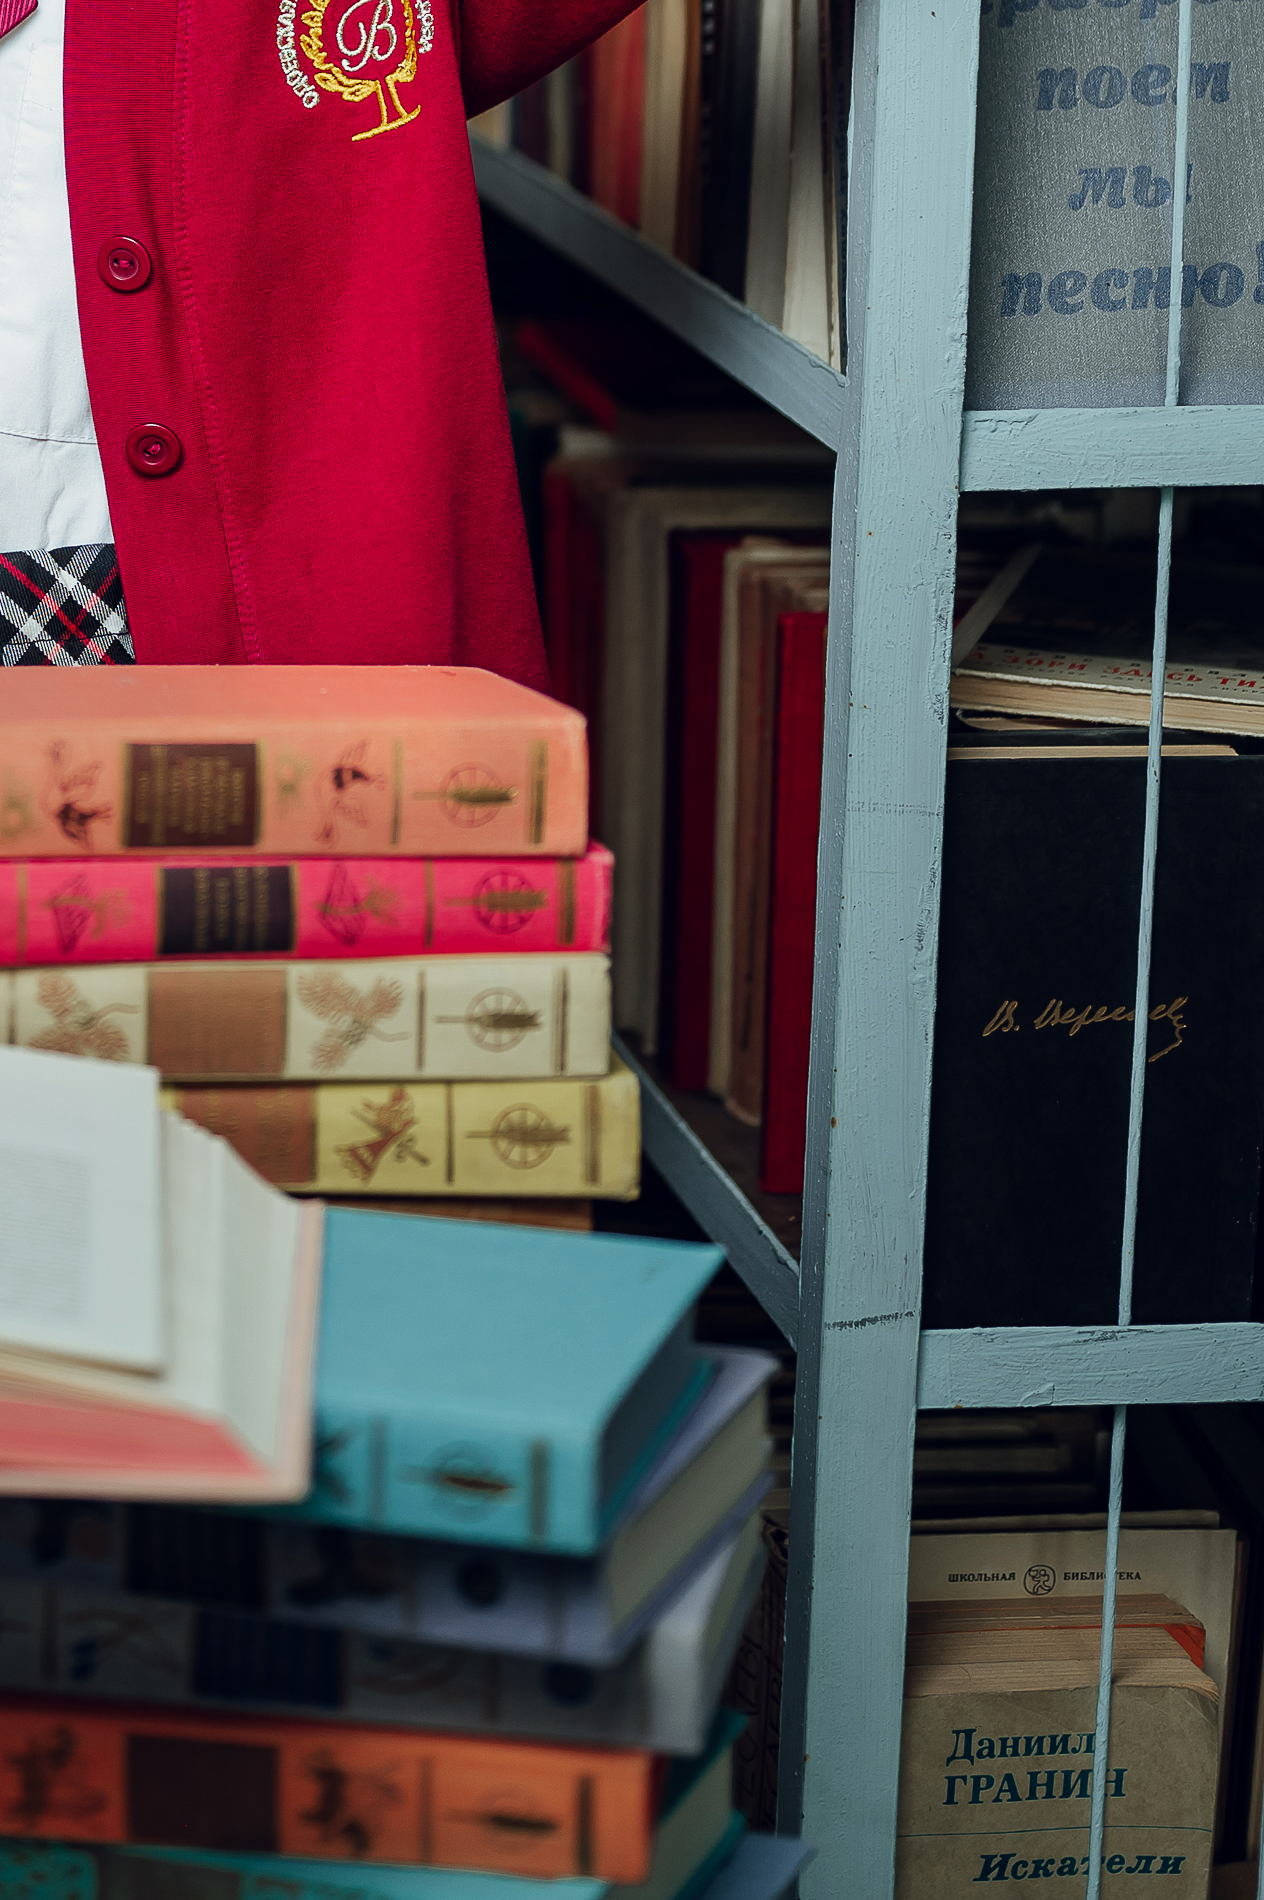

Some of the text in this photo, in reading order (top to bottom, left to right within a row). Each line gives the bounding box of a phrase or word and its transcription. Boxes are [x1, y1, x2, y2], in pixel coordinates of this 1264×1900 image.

[1035, 61, 1232, 111] поем
[1068, 163, 1194, 211] мы
[1215, 675, 1264, 690] ТИ
[948, 1572, 1016, 1583] ШКОЛЬНАЯ
[945, 1728, 1096, 1768] Даниил
[942, 1768, 1128, 1806] ГРАНИН
